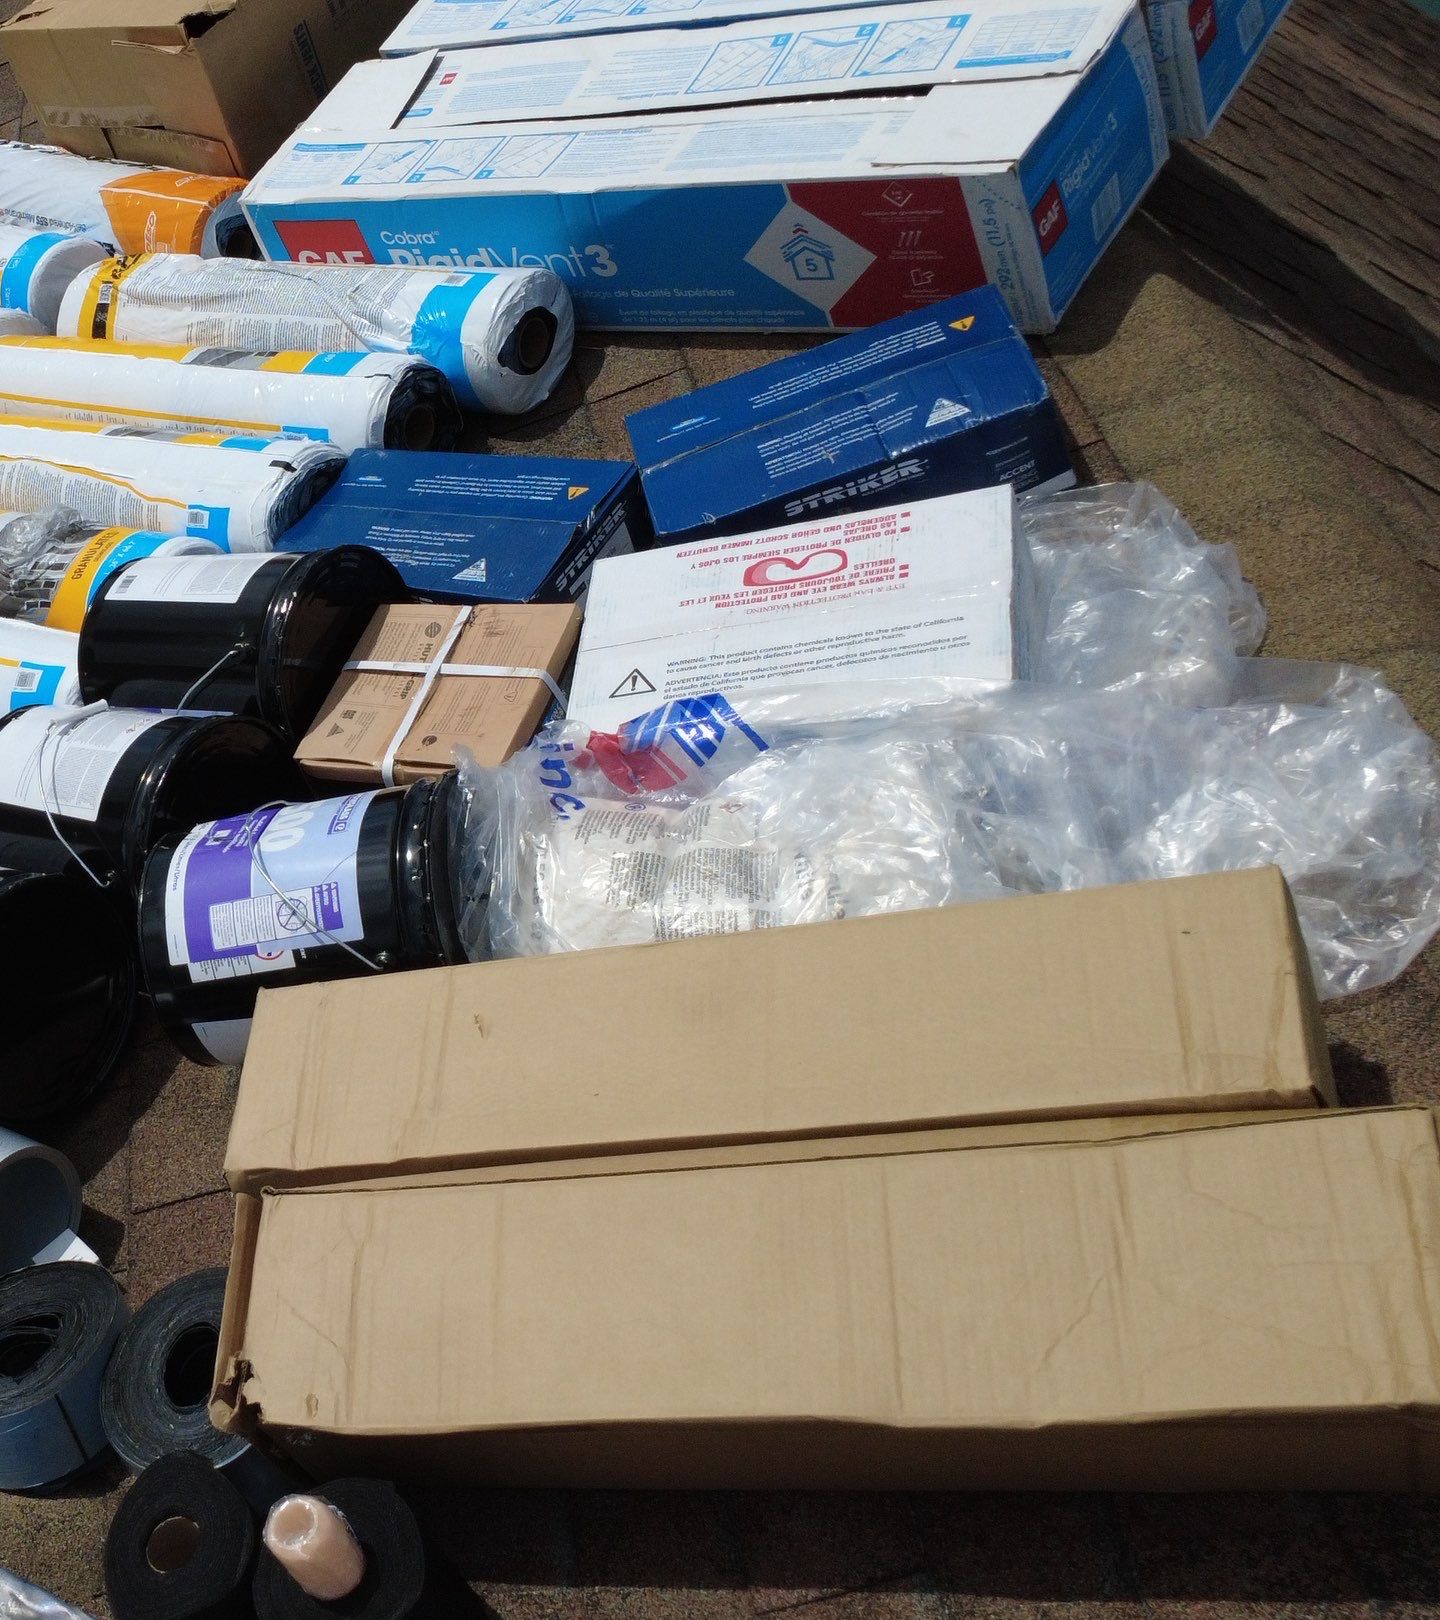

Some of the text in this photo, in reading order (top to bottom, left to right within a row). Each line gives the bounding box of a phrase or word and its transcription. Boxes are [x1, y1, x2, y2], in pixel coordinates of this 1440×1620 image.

[380, 229, 435, 247] Cobra
[805, 258, 816, 271] 5
[630, 287, 672, 298] Qualité
[673, 287, 735, 299] Supérieure
[784, 458, 929, 517] STRIKER
[842, 524, 878, 537] OREJAS
[830, 539, 842, 547] DE
[844, 531, 881, 544] OLVIDEN
[555, 499, 628, 592] STRIKER
[783, 541, 828, 555] PROTEGER
[723, 555, 739, 564] LOS
[741, 549, 781, 561] SIEMPRE
[853, 558, 896, 571] OREILLES
[679, 565, 896, 608] PRIERE DE TOUJOURS PROTEGER LES YEUX ET LES
[829, 581, 856, 591] WEAR
[858, 574, 895, 586] ALWAYS
[770, 593, 788, 601] EAR
[811, 587, 827, 595] EYE
[714, 595, 768, 609] PROTECTION
[709, 653, 725, 661] This
[726, 648, 758, 660] product
[759, 643, 793, 653] contains
[793, 637, 834, 648] chemicals
[835, 631, 864, 642] known
[875, 627, 889, 635] the
[890, 624, 911, 632] state
[913, 621, 922, 629] of
[923, 615, 965, 627] California
[676, 664, 698, 673] cause
[698, 660, 725, 670] cancer
[725, 657, 741, 666] and
[742, 653, 760, 663] birth
[762, 650, 793, 660] defects
[803, 643, 825, 654] other
[827, 637, 880, 650] reproductive
[881, 632, 906, 641] harm.
[723, 670, 740, 678] Este
[741, 665, 778, 677] producto
[779, 659, 814, 670] contiene
[815, 653, 858, 665] productos
[899, 637, 951, 651] reconocidos
[951, 634, 969, 643] por
[672, 683, 699, 692] estado
[711, 674, 749, 687] California
[749, 673, 766, 681] que
[767, 667, 805, 680] provocan
[878, 653, 890, 661] de
[890, 646, 939, 659] nacimiento
[947, 641, 971, 650] otros
[687, 684, 744, 697] reproductivos.
